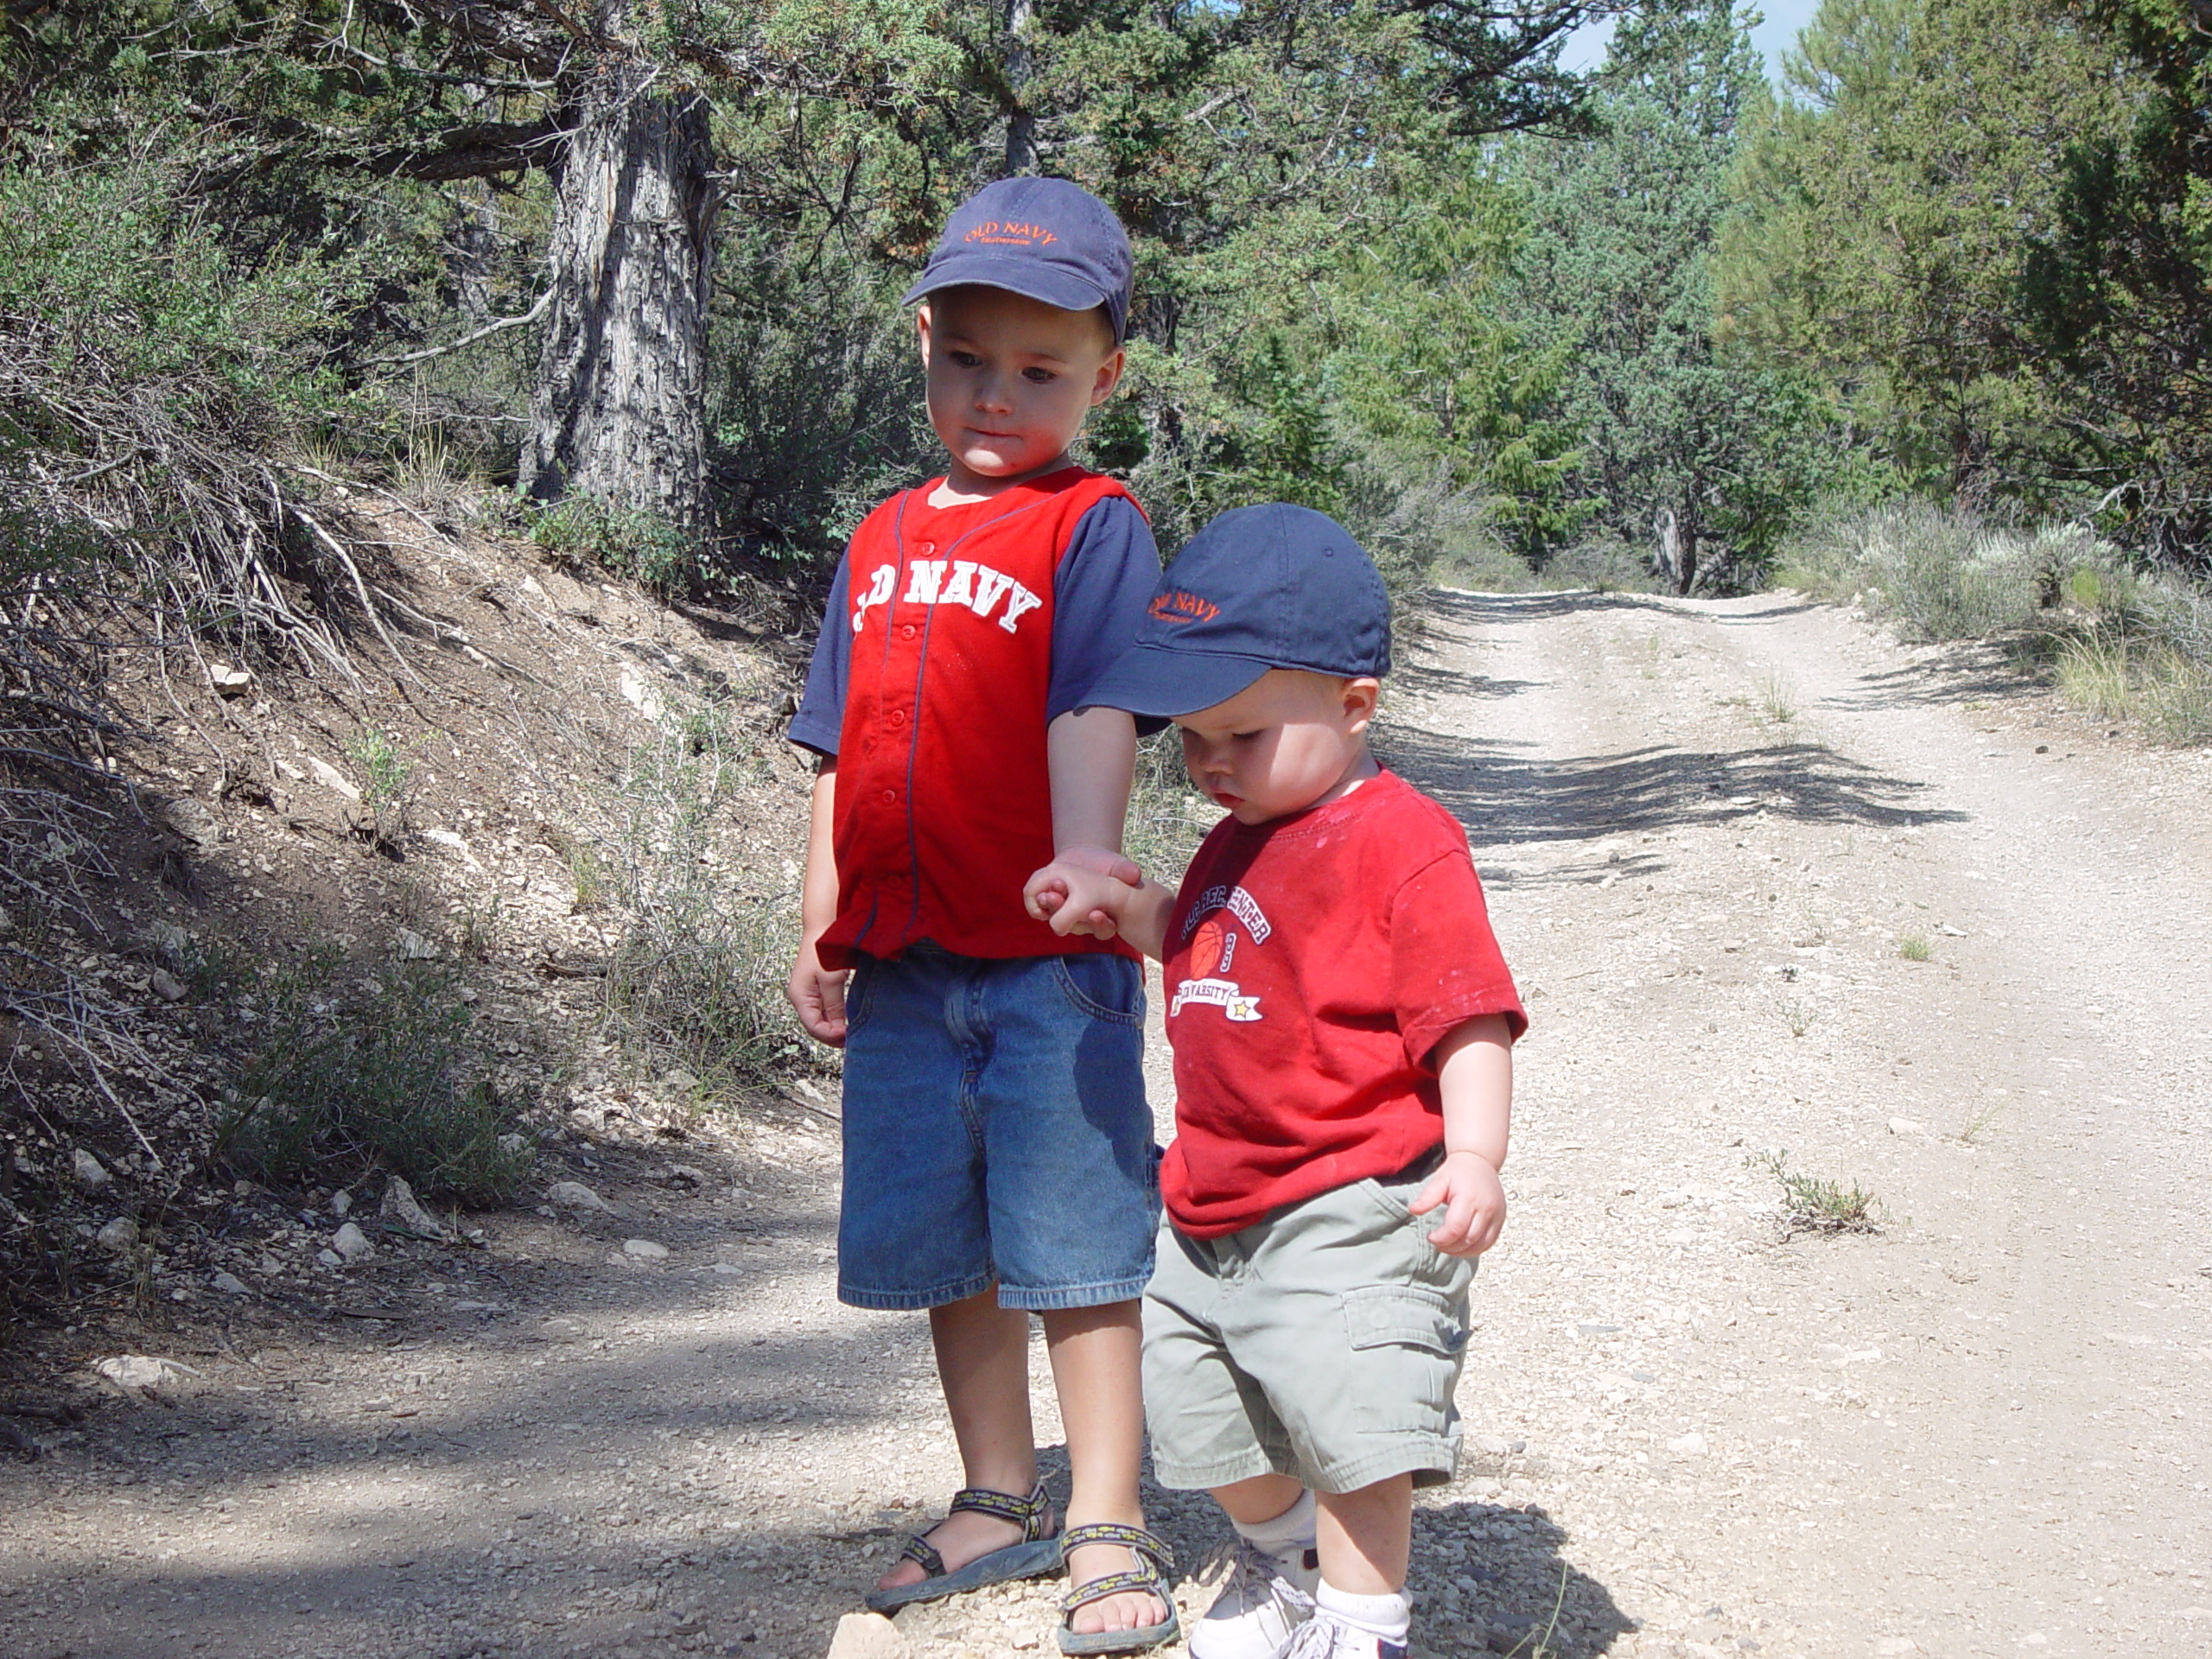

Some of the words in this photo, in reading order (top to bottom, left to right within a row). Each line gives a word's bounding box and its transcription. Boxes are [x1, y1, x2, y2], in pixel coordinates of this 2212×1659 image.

[964, 222, 999, 242] OLD
[1003, 222, 1058, 245] NAVY
[904, 560, 1042, 633] NAVY
[1173, 592, 1220, 621] NAVY
[1191, 984, 1230, 1001] VARSITY
